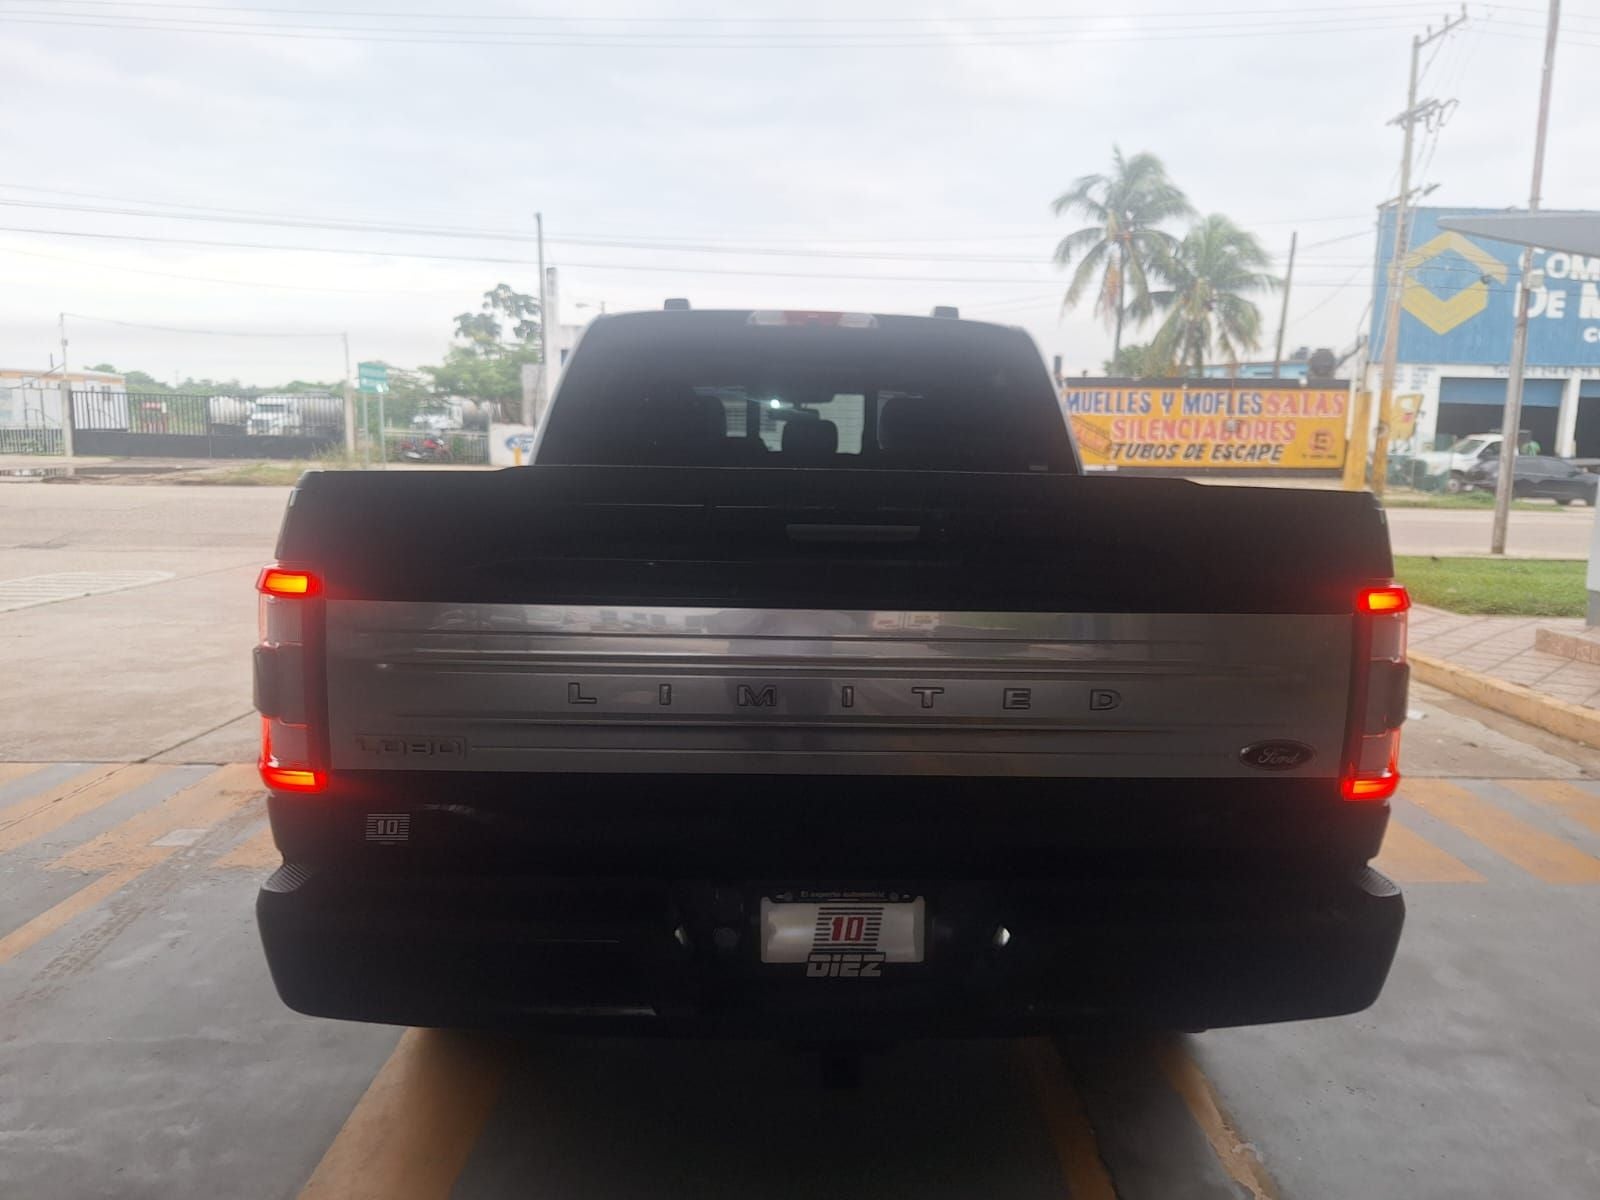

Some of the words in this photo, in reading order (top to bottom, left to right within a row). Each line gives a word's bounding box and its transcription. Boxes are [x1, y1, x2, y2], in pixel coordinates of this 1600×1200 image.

[1513, 282, 1567, 319] DE
[1066, 391, 1152, 414] MUELLES
[1161, 392, 1175, 415] Y
[1183, 392, 1263, 416] MOFLES
[1265, 392, 1345, 417] SALAS
[1112, 418, 1297, 442] SILENCIADORES
[1112, 442, 1179, 460] TUBOS
[1183, 443, 1206, 461] DE
[1211, 444, 1285, 462] ESCAPE
[567, 682, 1123, 712] LIMITED
[1257, 746, 1301, 765] Ford
[377, 819, 399, 835] 10
[831, 916, 864, 941] 10
[806, 953, 885, 977] DIEZ
